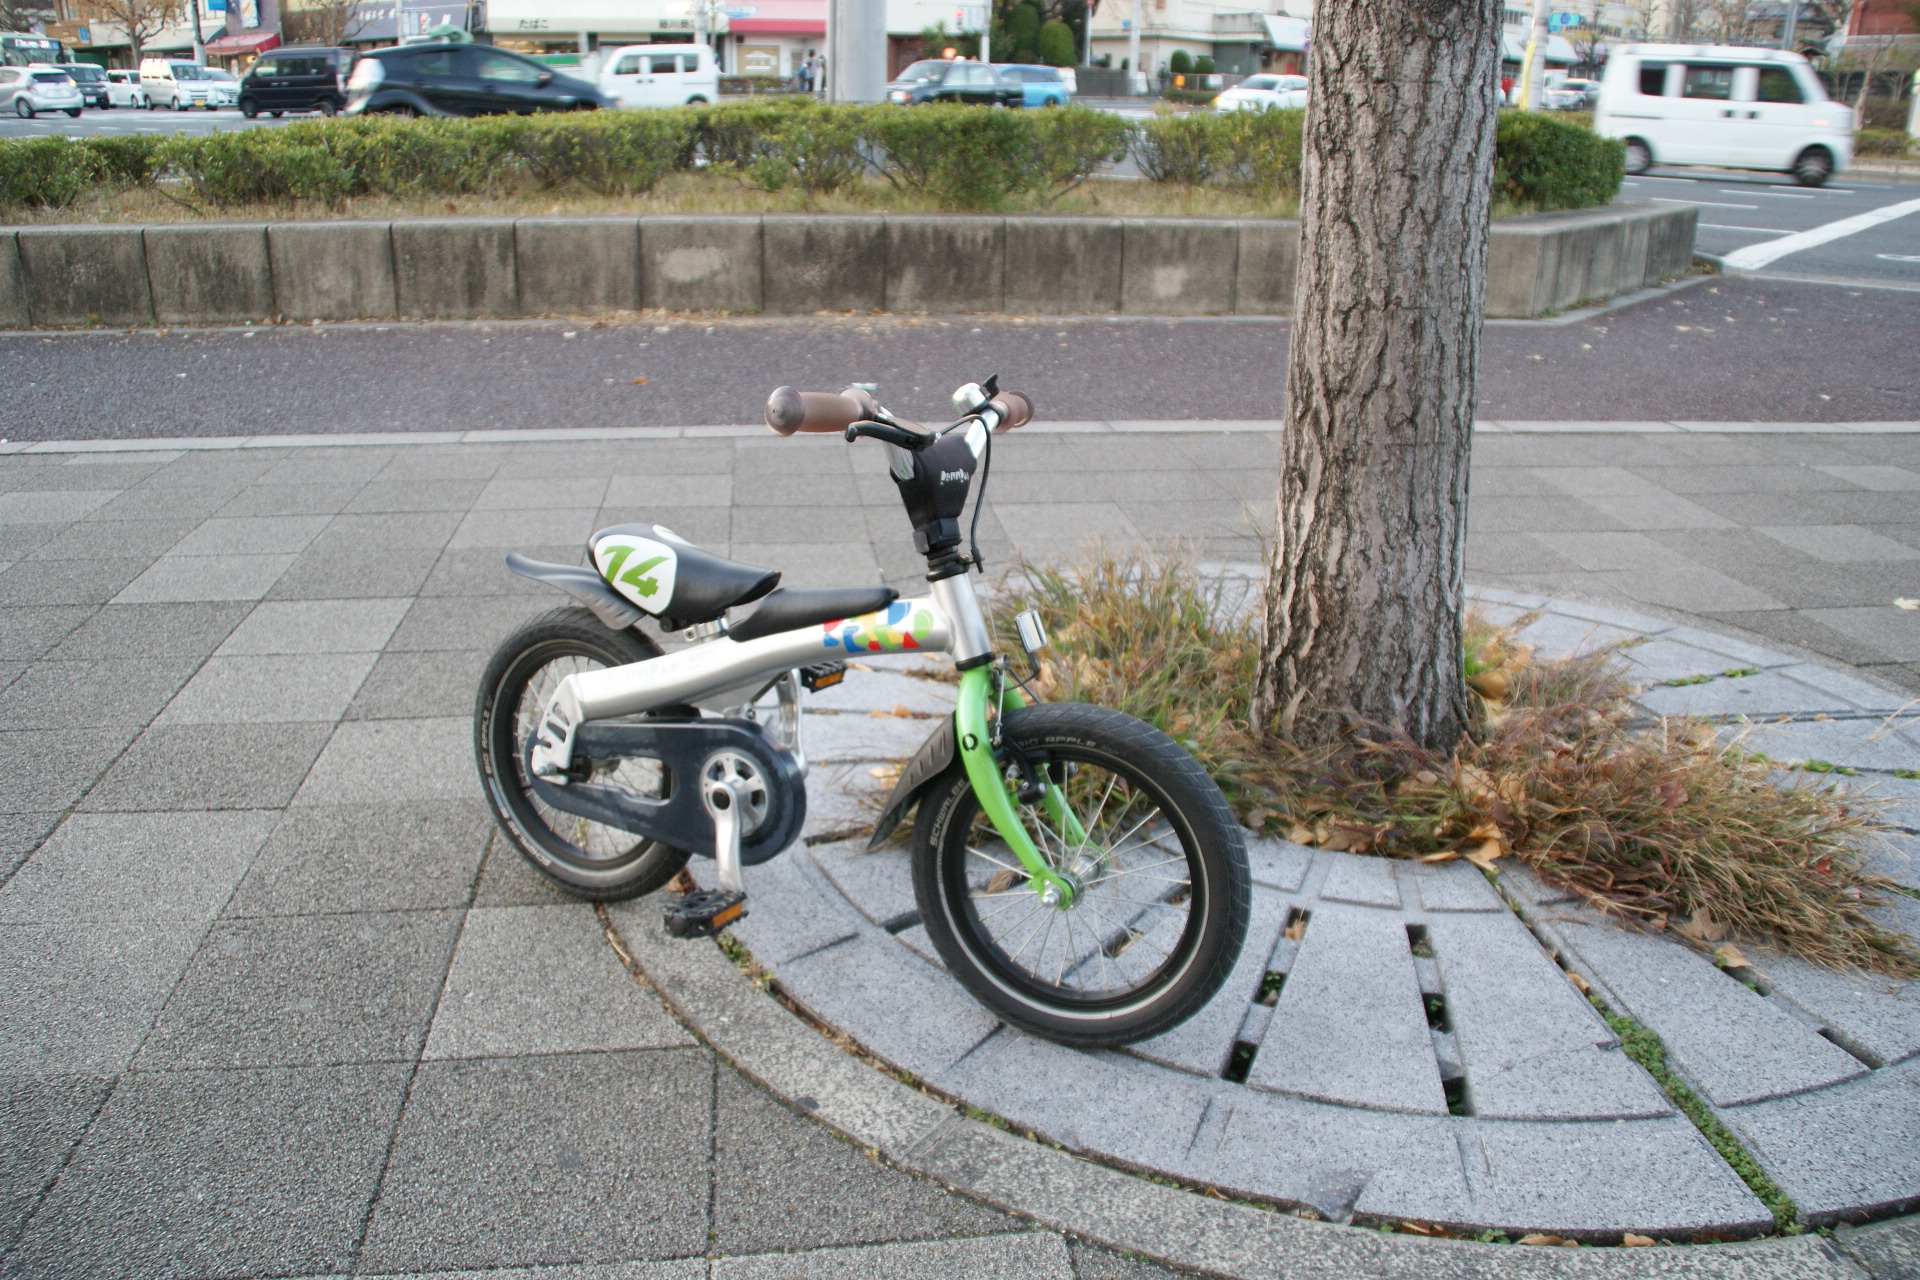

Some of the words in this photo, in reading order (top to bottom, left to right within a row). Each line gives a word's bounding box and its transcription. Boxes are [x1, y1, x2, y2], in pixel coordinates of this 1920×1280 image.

[519, 18, 549, 30] たばこ
[601, 545, 671, 598] 14
[481, 709, 490, 749] APPLE
[1045, 736, 1097, 748] APPLE
